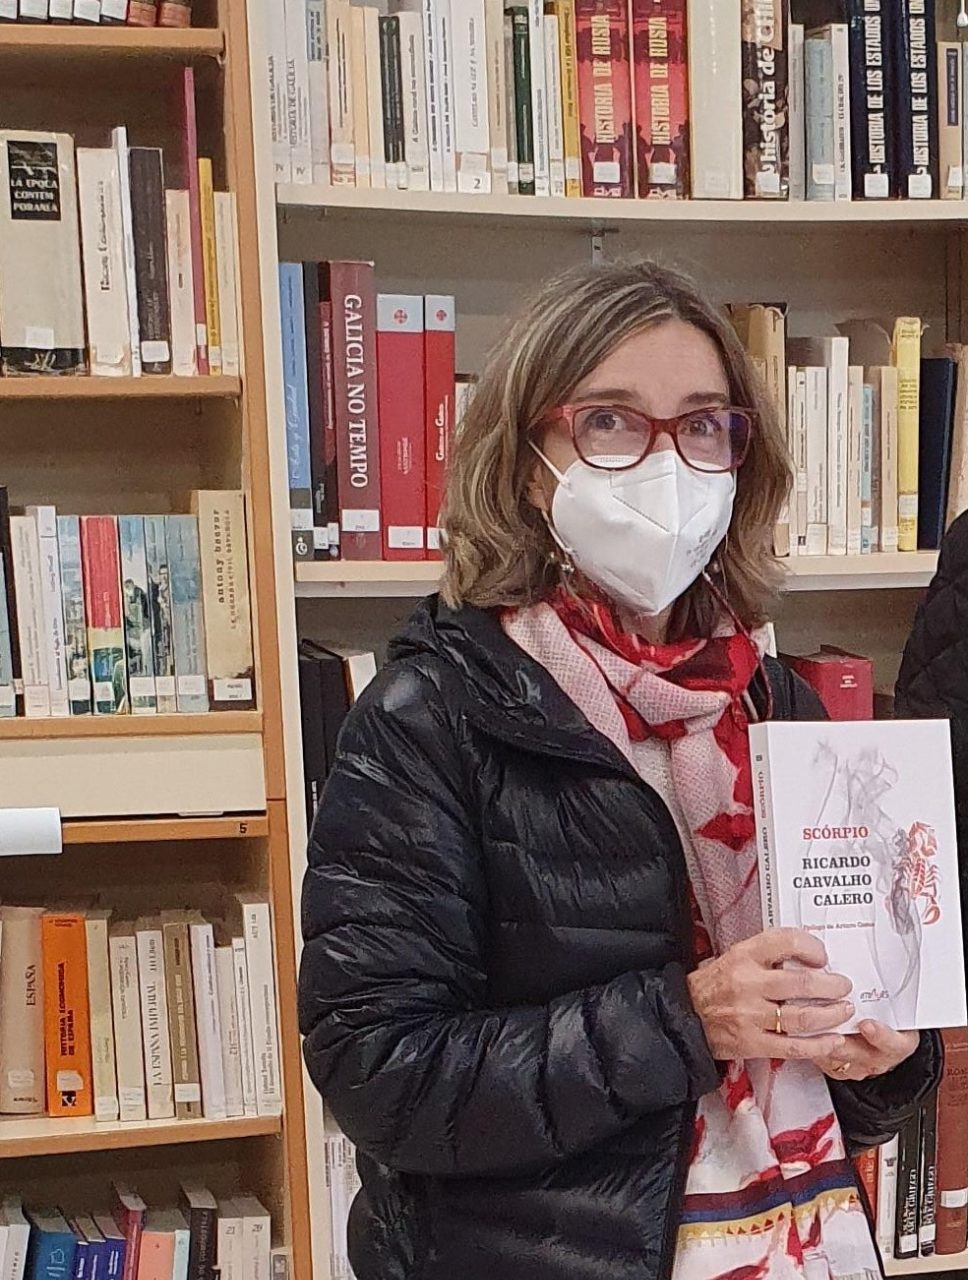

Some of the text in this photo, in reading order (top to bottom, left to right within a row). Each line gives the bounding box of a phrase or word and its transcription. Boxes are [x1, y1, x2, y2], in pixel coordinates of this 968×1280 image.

[909, 18, 927, 69] ESTADOS
[591, 15, 615, 143] HISTORIA DE RUSIA
[648, 17, 670, 145] HISTORIA DE RUSIA
[865, 15, 885, 164] HISTORIA DE LOS ESTADOS
[910, 72, 927, 94] LOS
[758, 48, 776, 162] historia de
[911, 96, 928, 111] DE
[912, 115, 930, 165] HISTORIA
[11, 179, 59, 189] LA EPOCA
[14, 191, 55, 200] CONTEM
[473, 178, 481, 189] 2
[13, 203, 58, 213] PORANEA
[344, 294, 368, 488] GALICIA NO TEMPO
[215, 558, 225, 603] antony
[239, 823, 247, 834] 5
[802, 824, 869, 840] SCÓRPIO
[760, 826, 771, 873] CALERO
[802, 856, 871, 869] RICARDO
[793, 874, 872, 889] CARVALHO
[813, 892, 873, 907] CALERO
[25, 964, 36, 1006] ESPAÑA
[146, 982, 163, 1086] LA ESPAÑA IMPERIAL
[908, 1168, 917, 1207] GRIEGO
